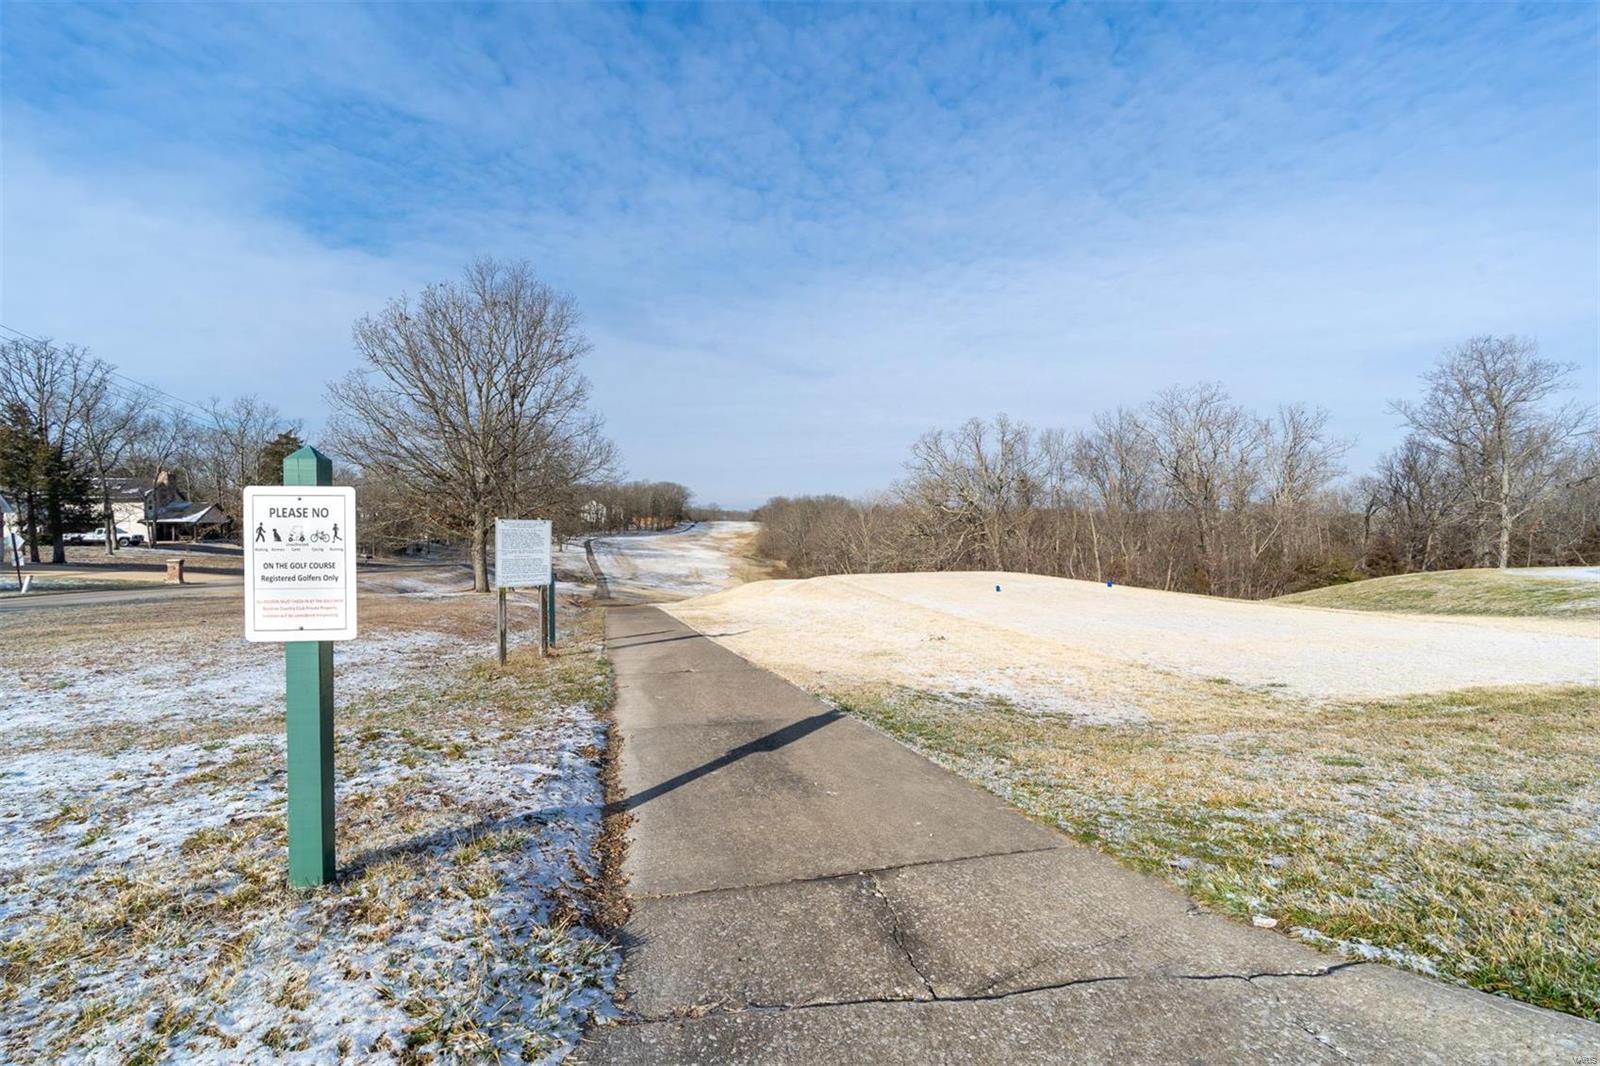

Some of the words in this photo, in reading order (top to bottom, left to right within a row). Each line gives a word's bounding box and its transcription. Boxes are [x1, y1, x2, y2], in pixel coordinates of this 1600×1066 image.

[269, 507, 309, 518] PLEASE
[311, 507, 329, 518] NO
[263, 562, 274, 570] ON
[275, 562, 288, 570] THE
[289, 562, 308, 570] GOLF
[308, 562, 336, 570] COURSE
[261, 575, 296, 583] Registered
[297, 574, 322, 582] Golfers
[322, 574, 339, 583] Only
